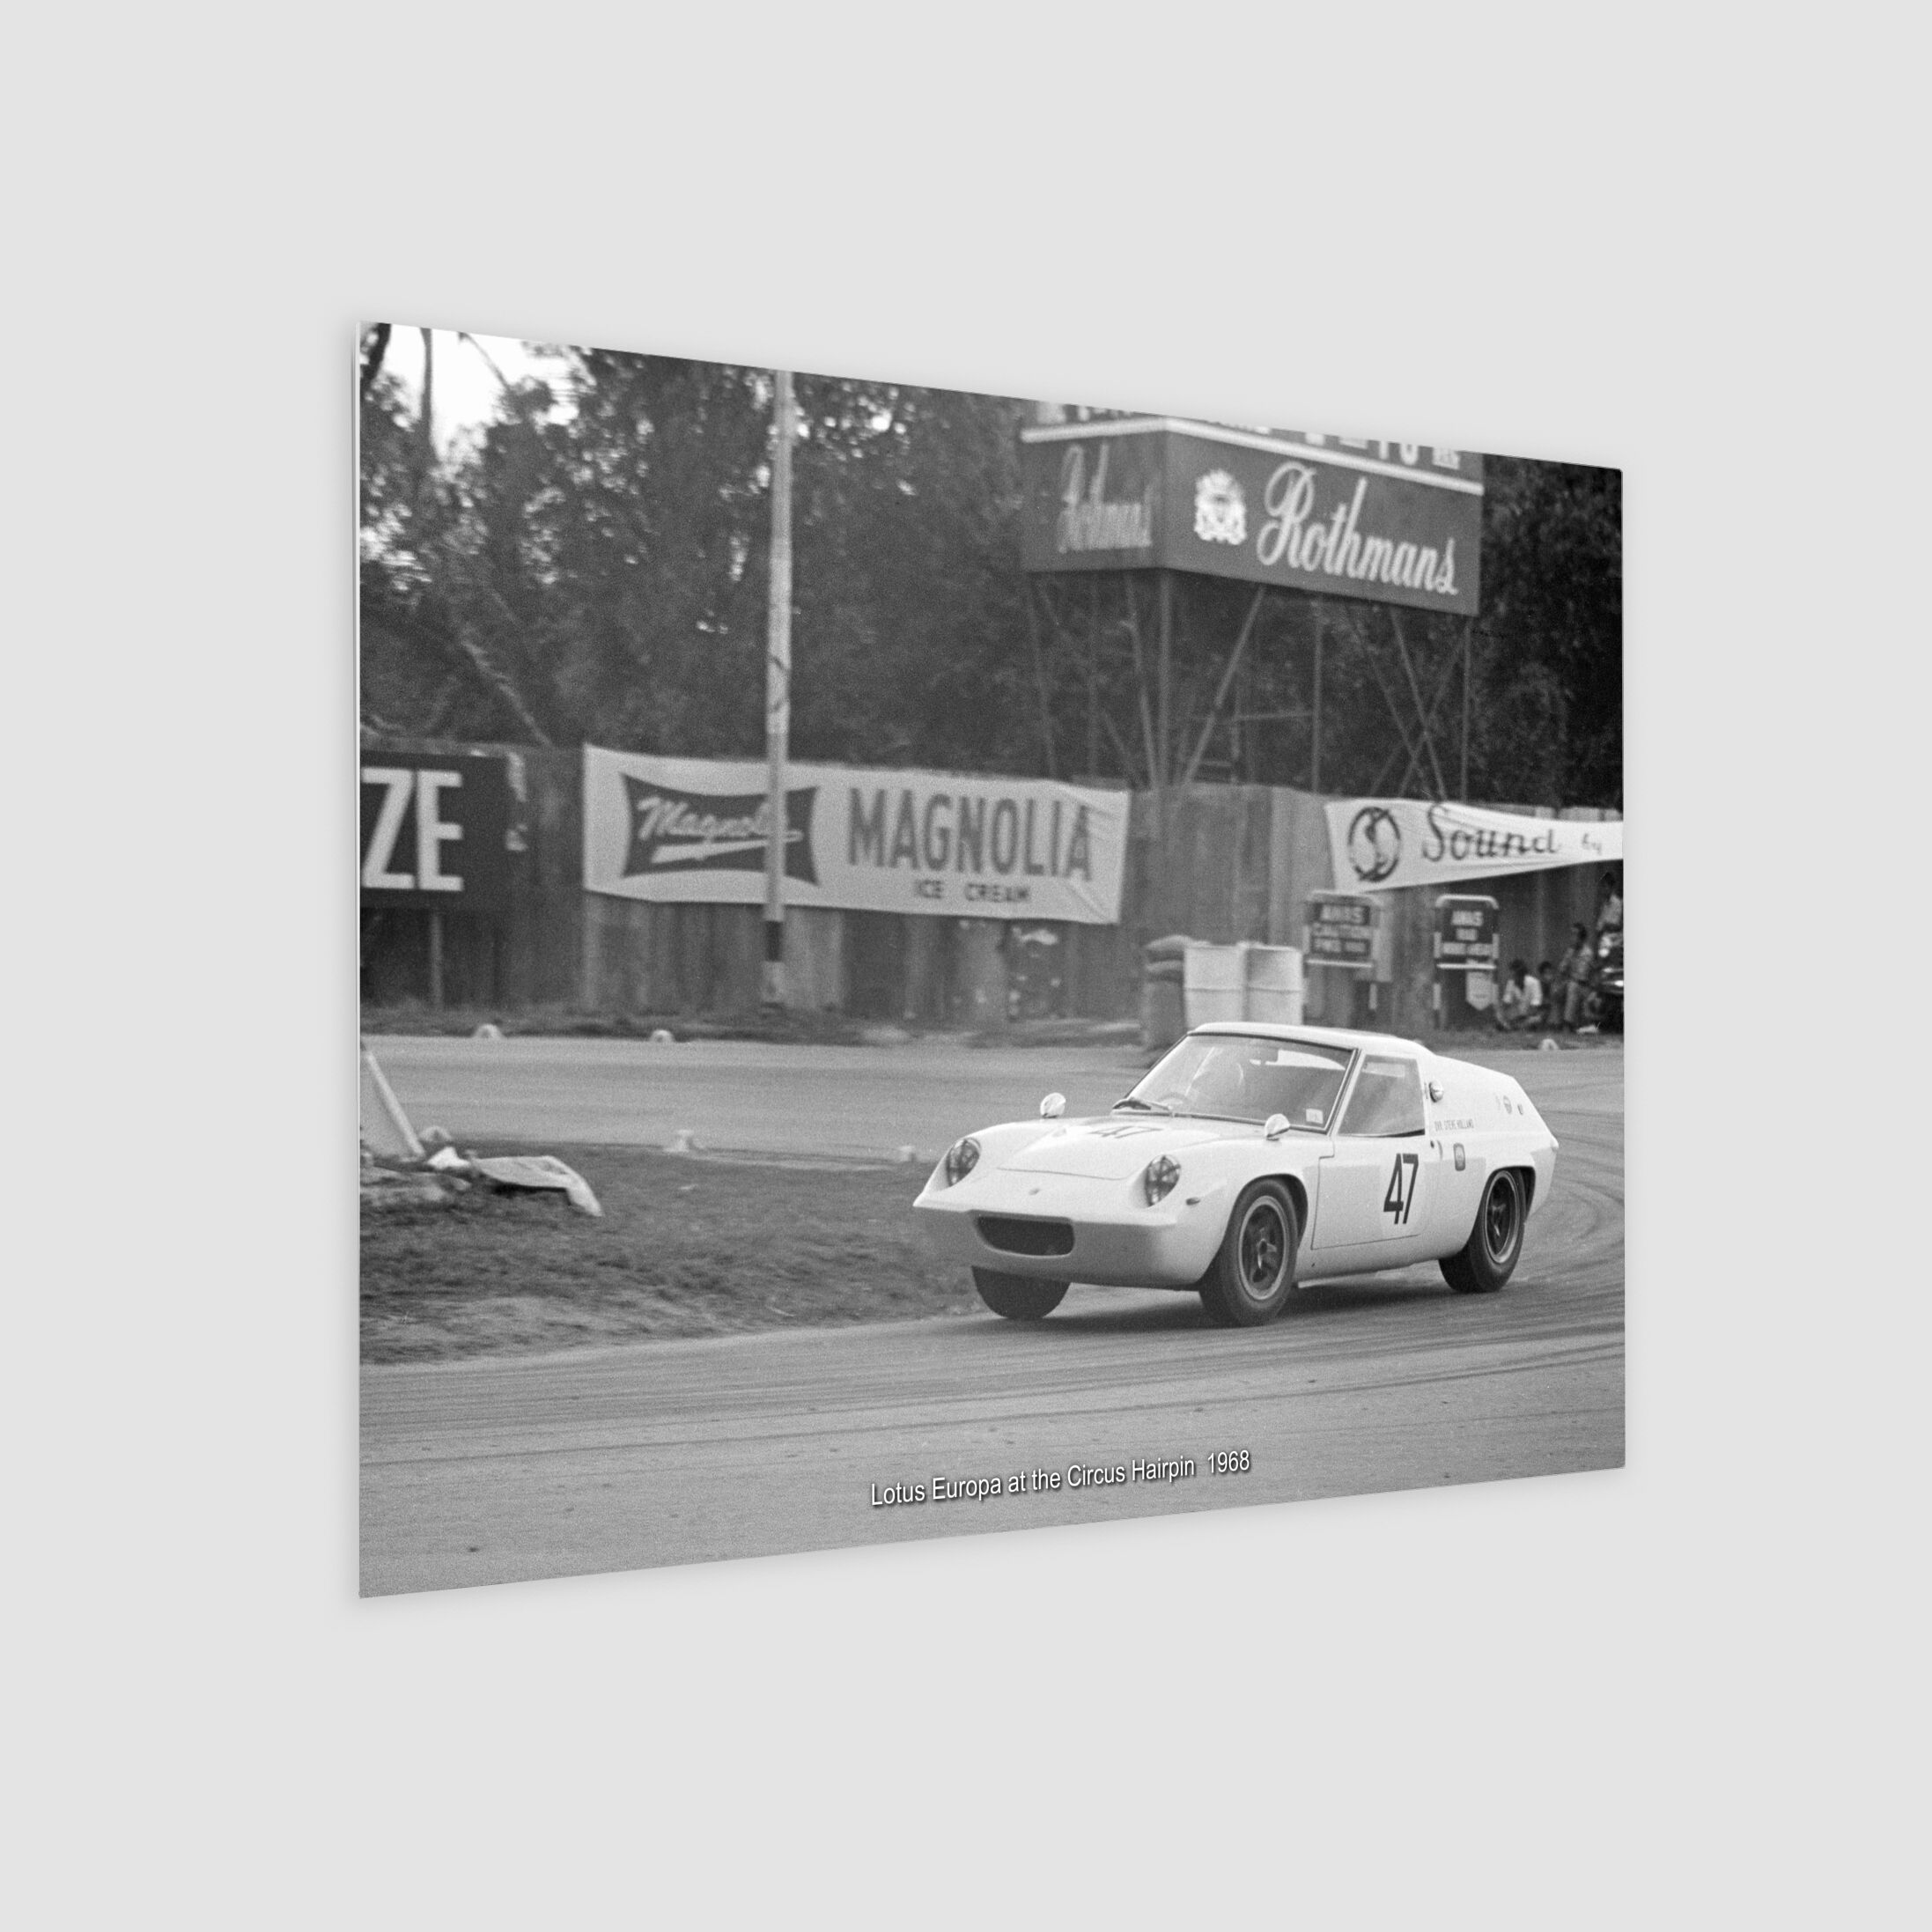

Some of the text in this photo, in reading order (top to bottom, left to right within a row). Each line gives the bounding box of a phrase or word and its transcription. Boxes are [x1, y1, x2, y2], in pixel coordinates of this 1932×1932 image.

[1257, 461, 1457, 595] Rothmans
[362, 768, 463, 891] ZE
[848, 786, 1093, 881] MAGNOLIA
[1422, 802, 1556, 862] Sound
[915, 881, 1029, 903] ICE CREAM
[1383, 1153, 1419, 1224] 47
